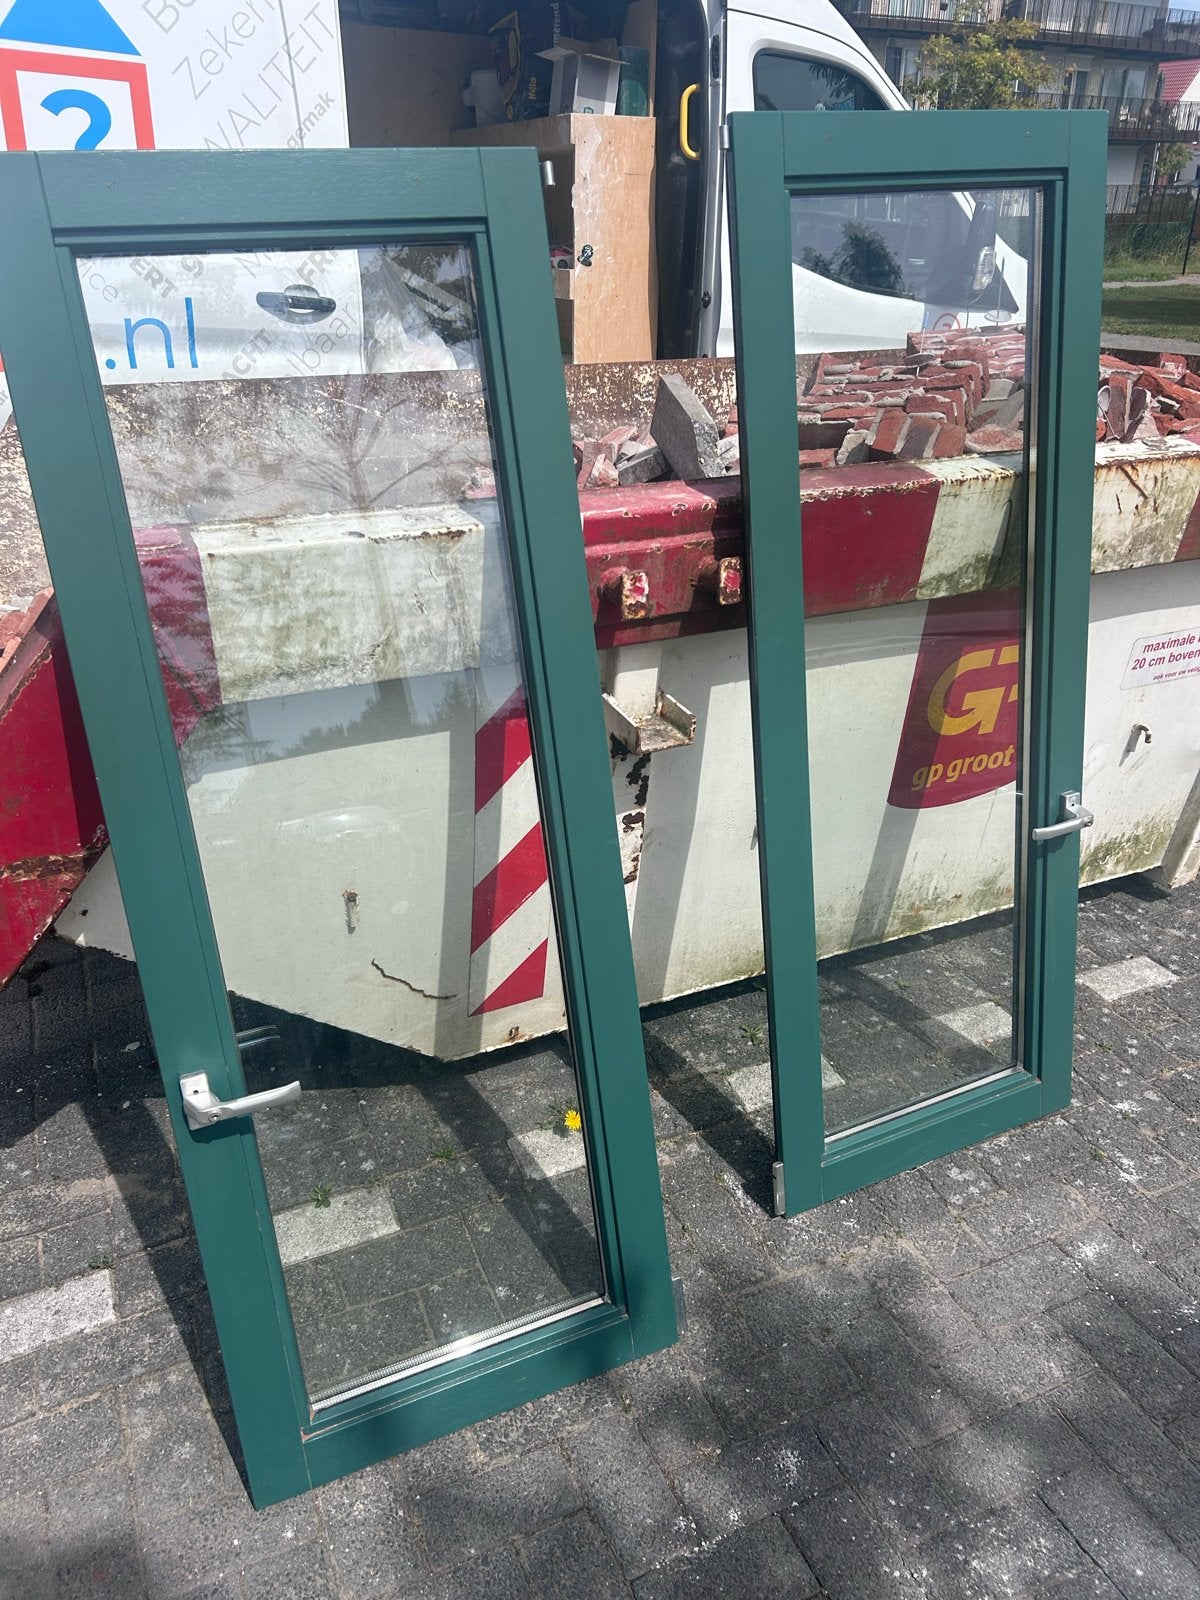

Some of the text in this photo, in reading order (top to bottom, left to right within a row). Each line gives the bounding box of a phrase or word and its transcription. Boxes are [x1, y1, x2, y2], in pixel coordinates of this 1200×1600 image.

[105, 297, 199, 371] .nl
[1143, 634, 1196, 653] maximale
[1131, 657, 1147, 671] 20
[1148, 655, 1166, 667] cm
[911, 744, 1015, 791] gp groot
